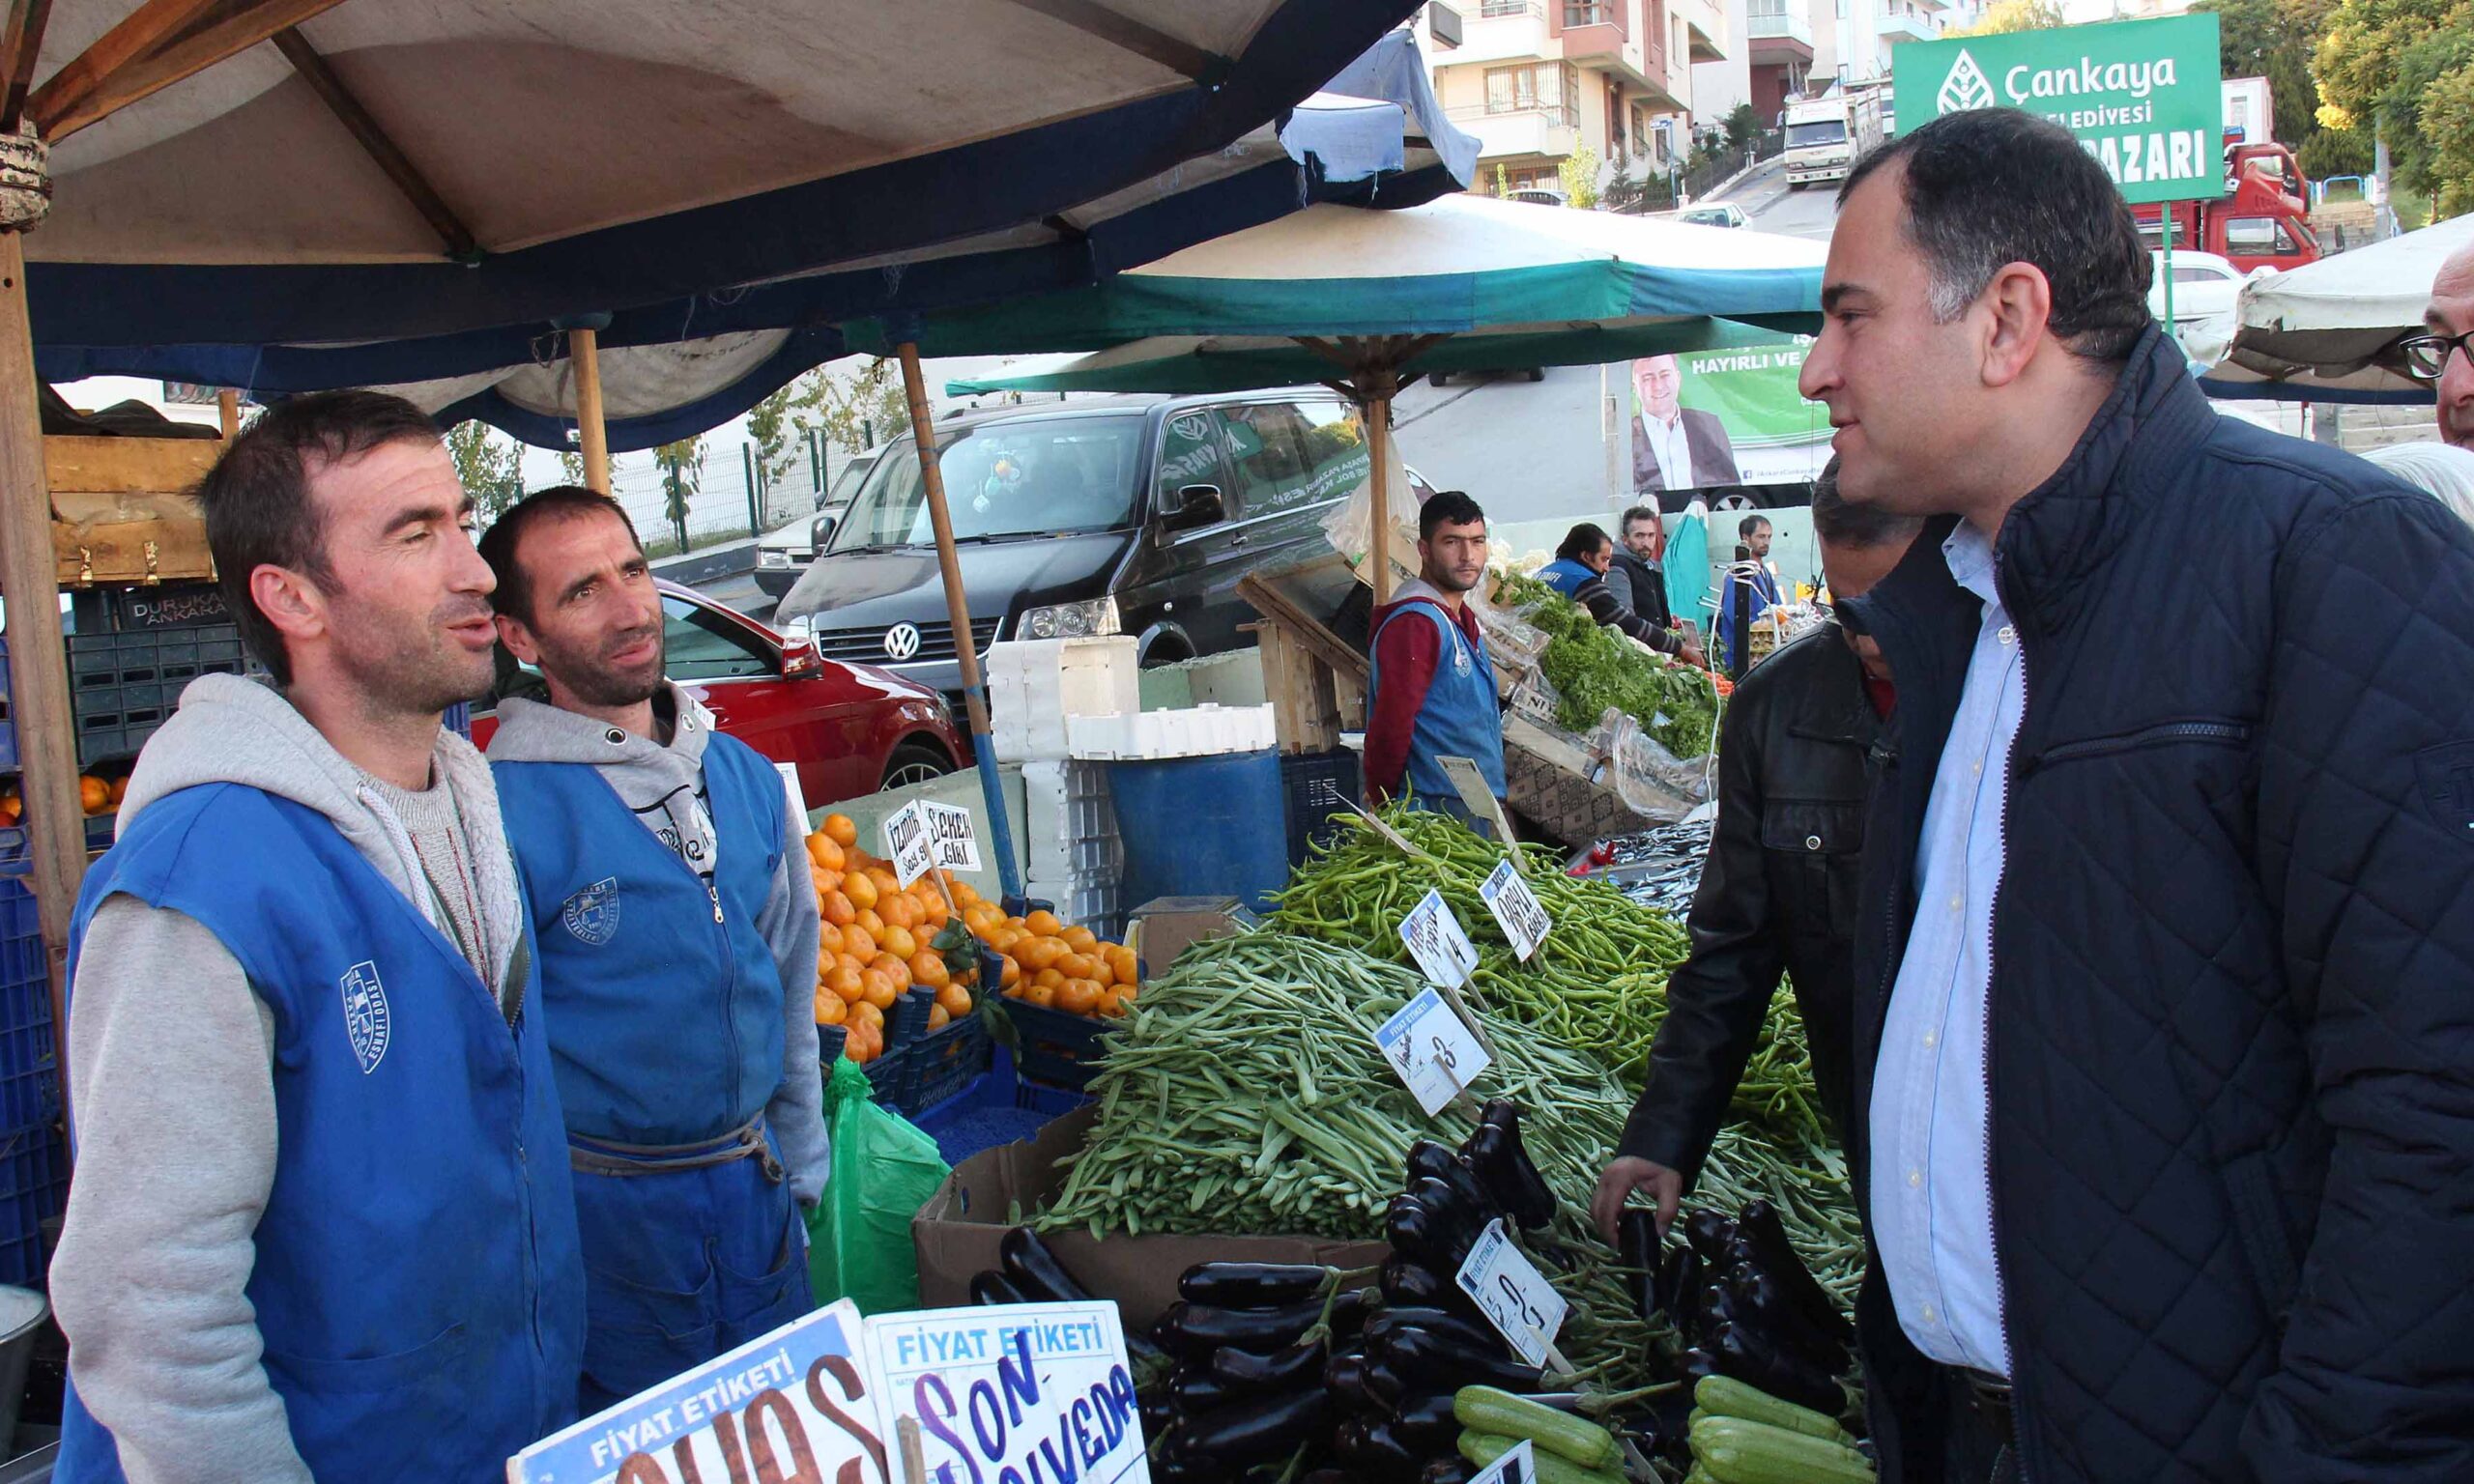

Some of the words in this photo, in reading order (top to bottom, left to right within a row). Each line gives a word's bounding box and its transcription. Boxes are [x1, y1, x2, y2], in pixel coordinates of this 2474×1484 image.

[2004, 56, 2176, 105] Çankaya
[2046, 100, 2152, 128] ELEDİYESİ
[1692, 355, 1769, 374] HAYIRLI
[1774, 352, 1800, 366] VE
[147, 603, 227, 626] ANKARA
[1431, 1036, 1457, 1070] 3
[896, 1326, 987, 1364] FİYAT
[998, 1315, 1104, 1356] ETİKETİ
[590, 1411, 674, 1469] FİYAT
[682, 1347, 796, 1424] ETİKETİ
[914, 1329, 1040, 1484] SON
